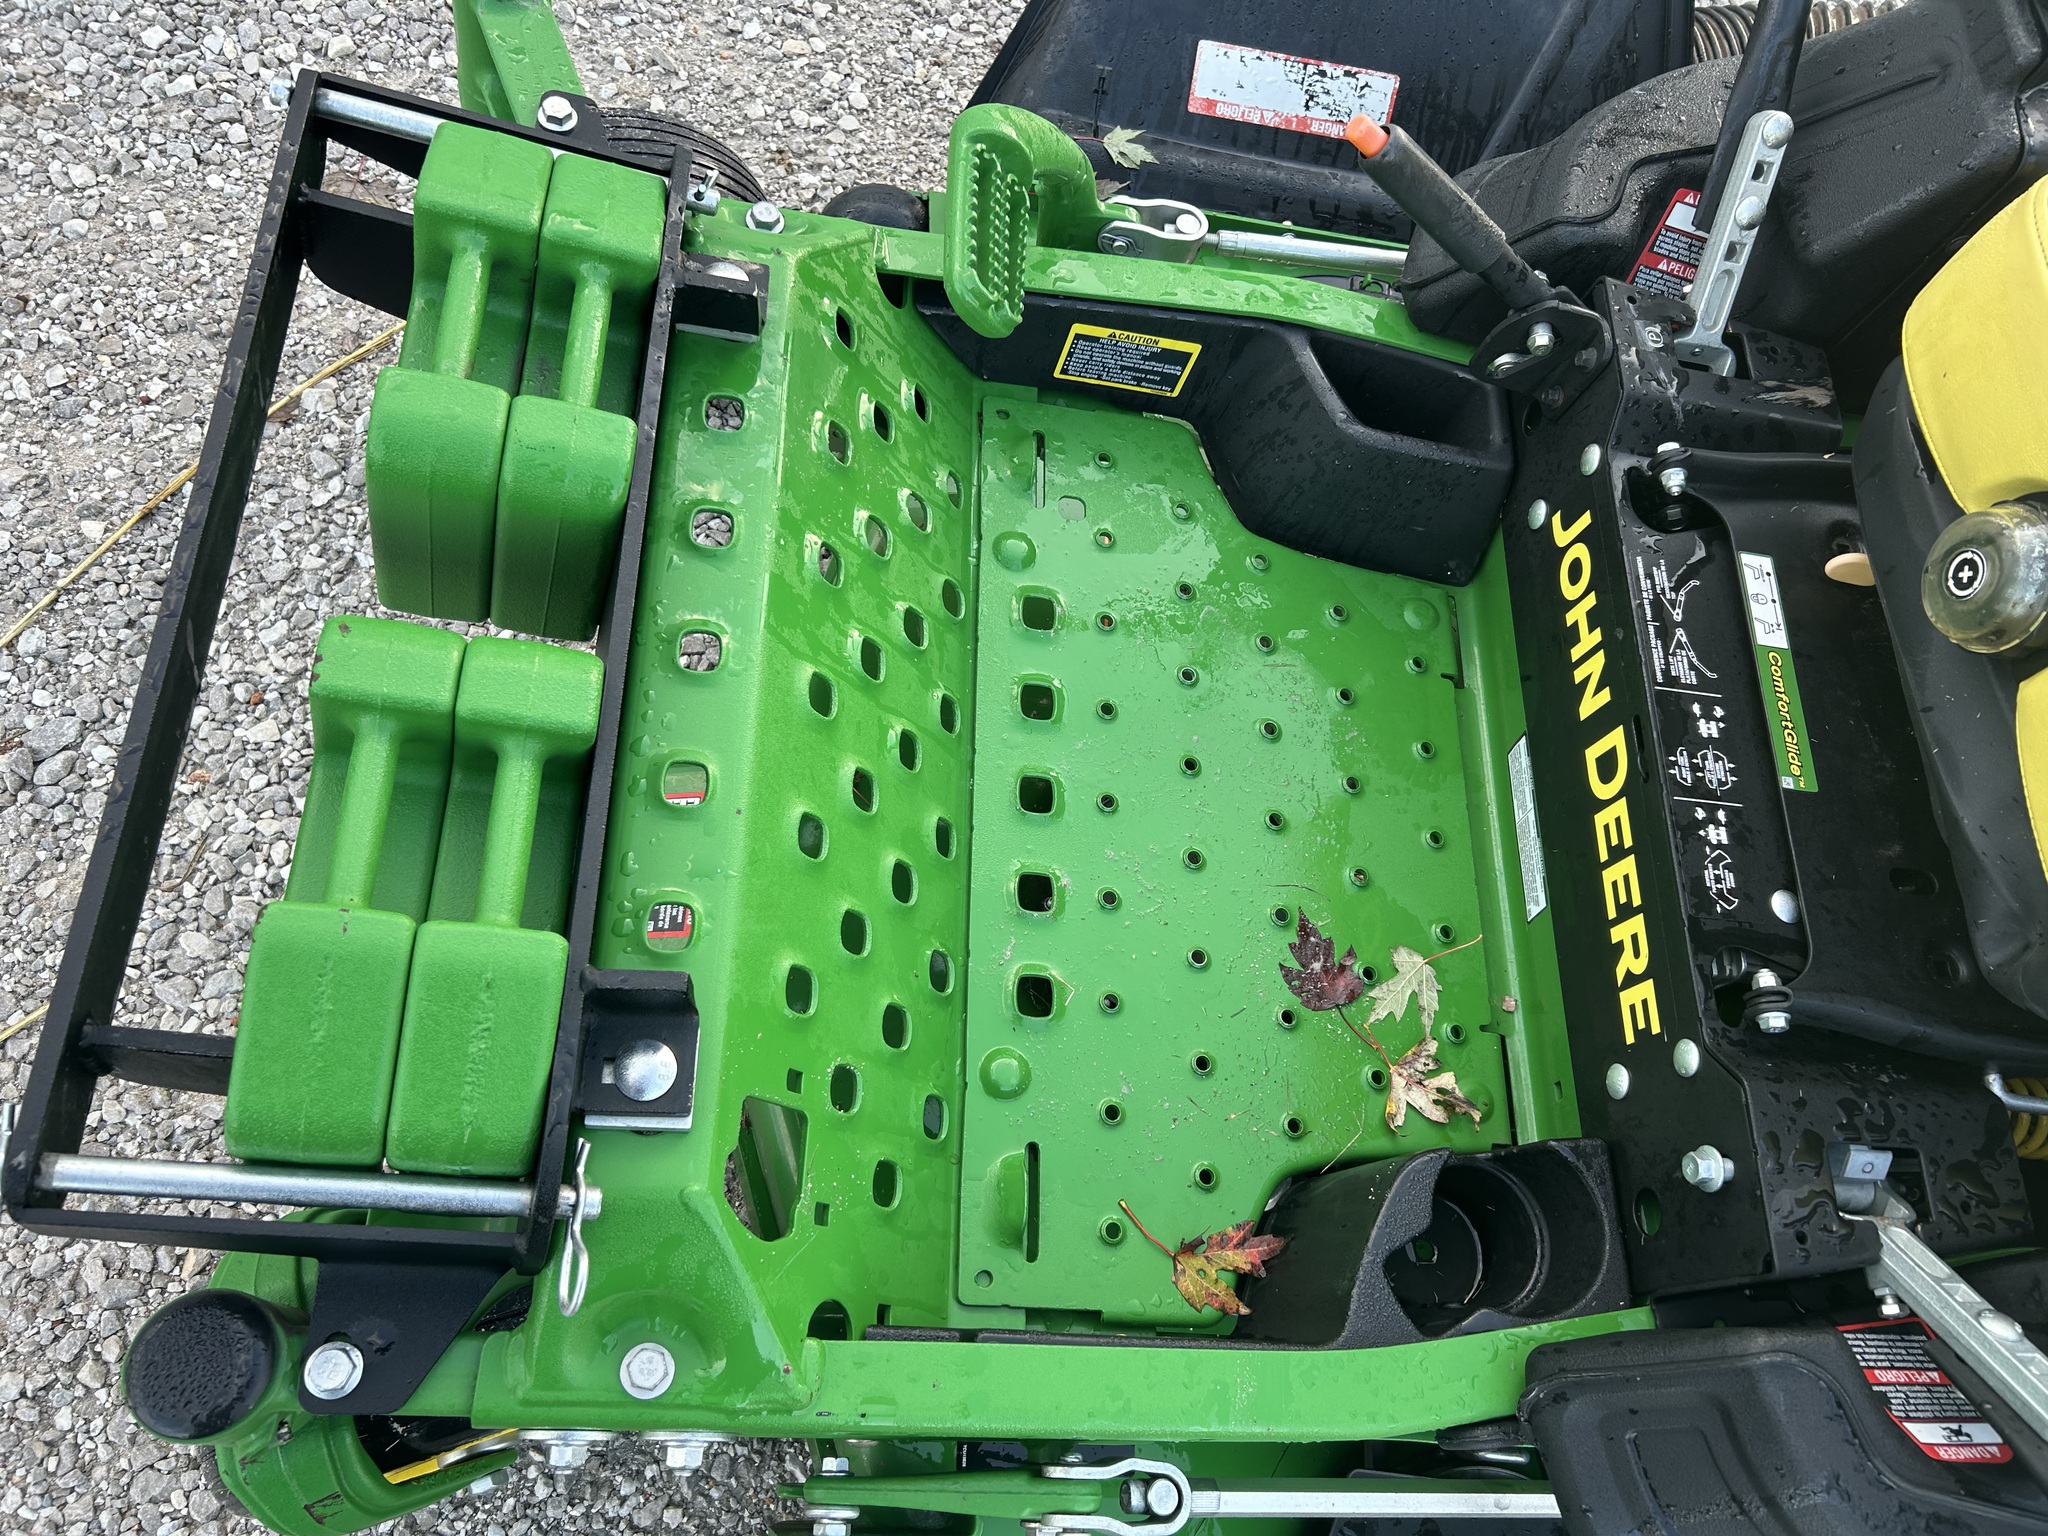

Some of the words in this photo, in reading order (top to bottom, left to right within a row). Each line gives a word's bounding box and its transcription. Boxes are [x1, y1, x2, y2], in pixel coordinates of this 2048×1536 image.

[1216, 101, 1263, 121] PELIGRO
[1310, 119, 1346, 137] ANGER
[1652, 247, 1669, 255] blades
[1658, 242, 1678, 252] machine
[1668, 262, 1695, 280] PELIG
[1117, 333, 1159, 345] CAUTION
[1103, 344, 1125, 352] training
[1126, 348, 1150, 356] required
[1551, 509, 1611, 722] JOHN
[1584, 724, 1661, 1046] DEERE
[1874, 1370, 1931, 1384] PELIGRO
[1933, 1445, 1990, 1460] DANGER
